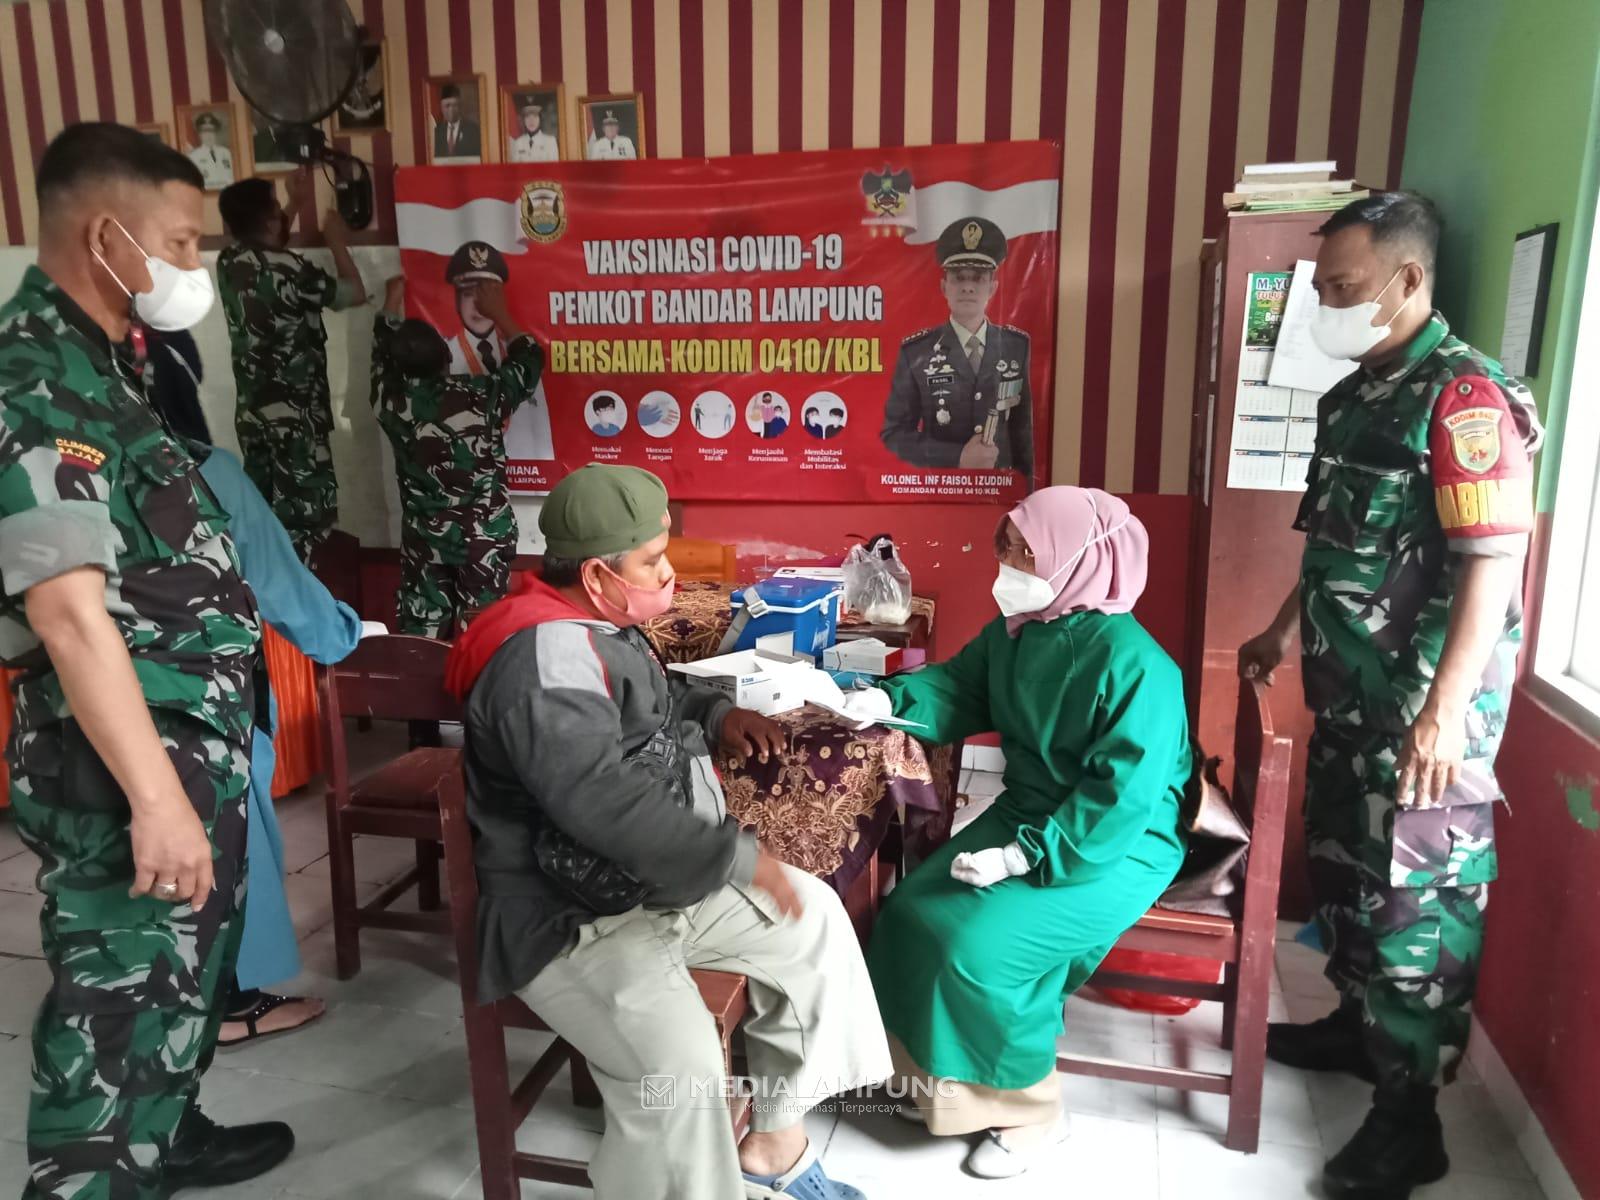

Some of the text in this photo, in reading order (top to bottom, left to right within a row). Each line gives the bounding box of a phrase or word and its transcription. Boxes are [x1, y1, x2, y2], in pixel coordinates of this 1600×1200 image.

[583, 233, 842, 275] VAKSINASI COVID-19
[549, 285, 882, 324] PEMKOT BANDAR LAMPUNG
[551, 338, 882, 373] BERSAMA KODIM 0410/KBL
[881, 474, 1013, 486] KOLONEL INF FAISOL IZUDDIN
